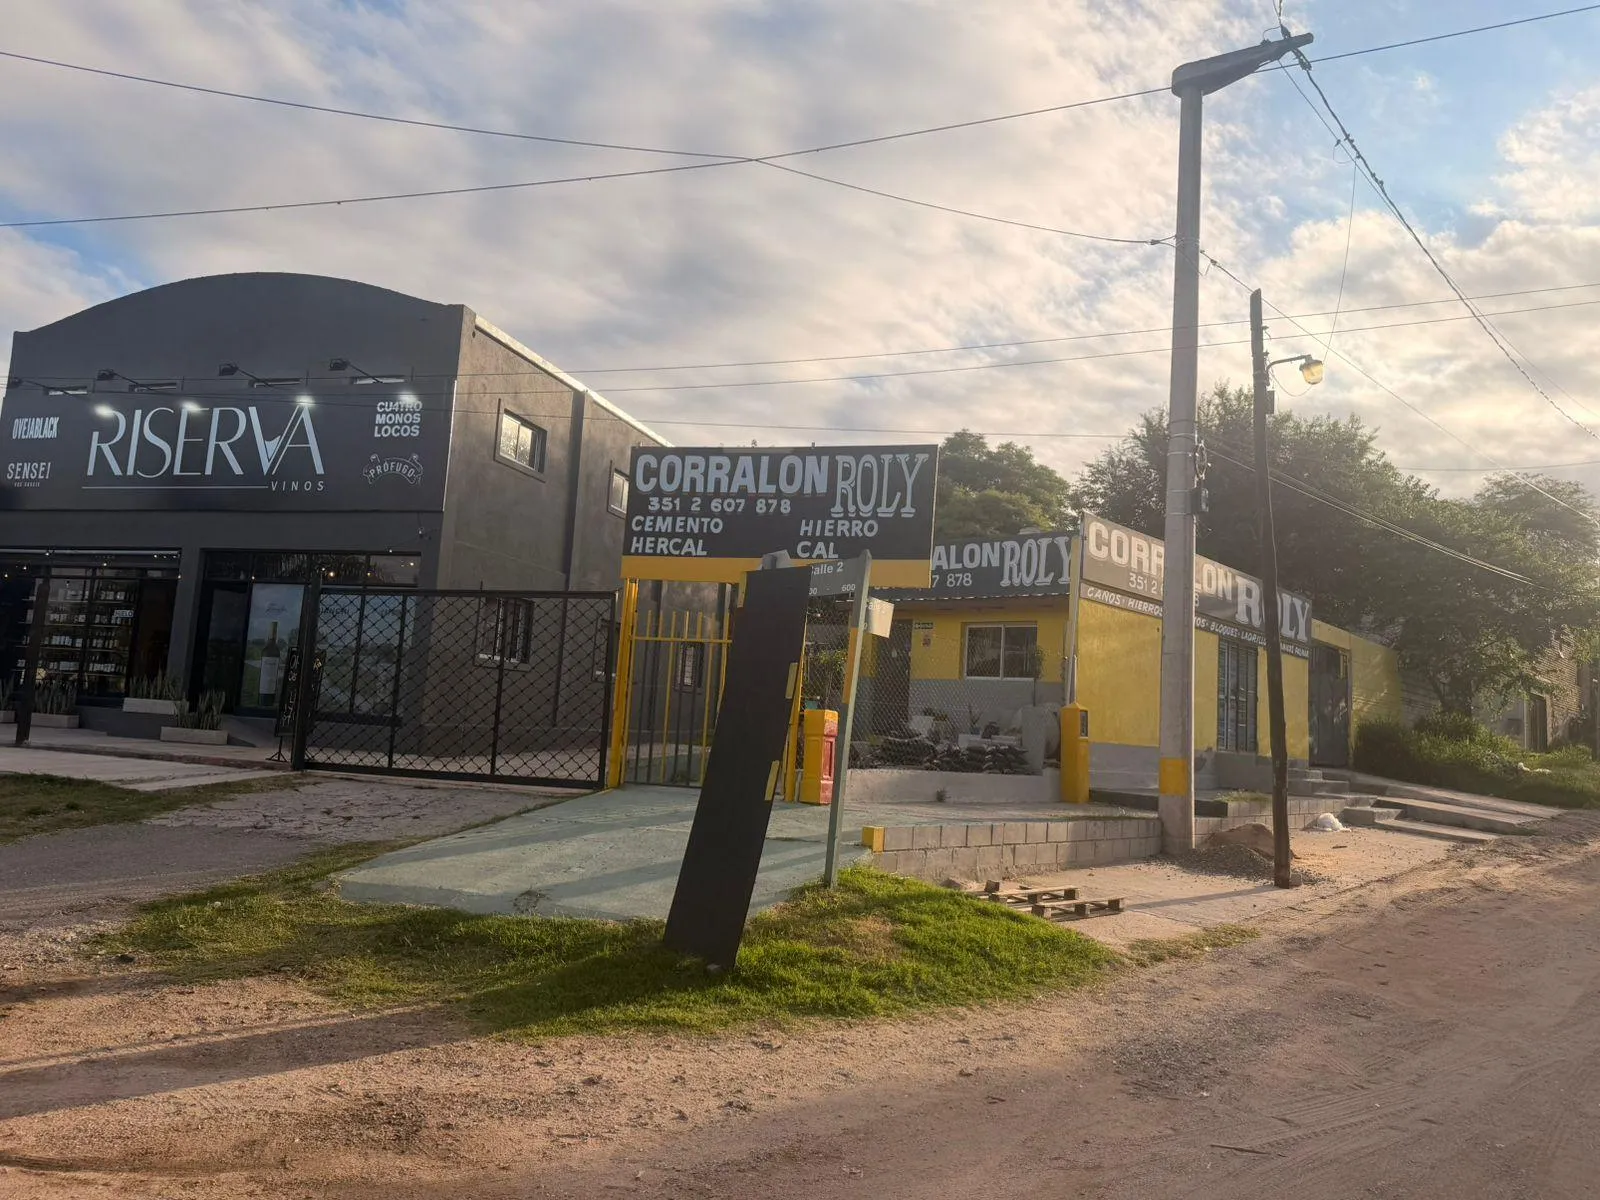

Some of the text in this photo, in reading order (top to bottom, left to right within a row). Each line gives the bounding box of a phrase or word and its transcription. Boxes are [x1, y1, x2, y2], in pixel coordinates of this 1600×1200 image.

[375, 413, 421, 424] MONOS
[374, 425, 420, 437] LOCOS
[87, 404, 325, 478] RISERVA
[6, 462, 51, 480] SENSEI
[271, 480, 324, 492] VINOS
[635, 453, 929, 518] CORRALON ROLY
[648, 497, 792, 515] 351 2 607 878
[631, 516, 724, 534] CEMENTO
[799, 519, 879, 538] HIERRO
[630, 537, 708, 556] HERCAL
[796, 540, 839, 559] CAL
[812, 562, 844, 575] alle 2
[1000, 536, 1072, 587] ROLY
[946, 573, 973, 588] 878
[1129, 573, 1148, 592] 351
[1235, 575, 1310, 642] RLY
